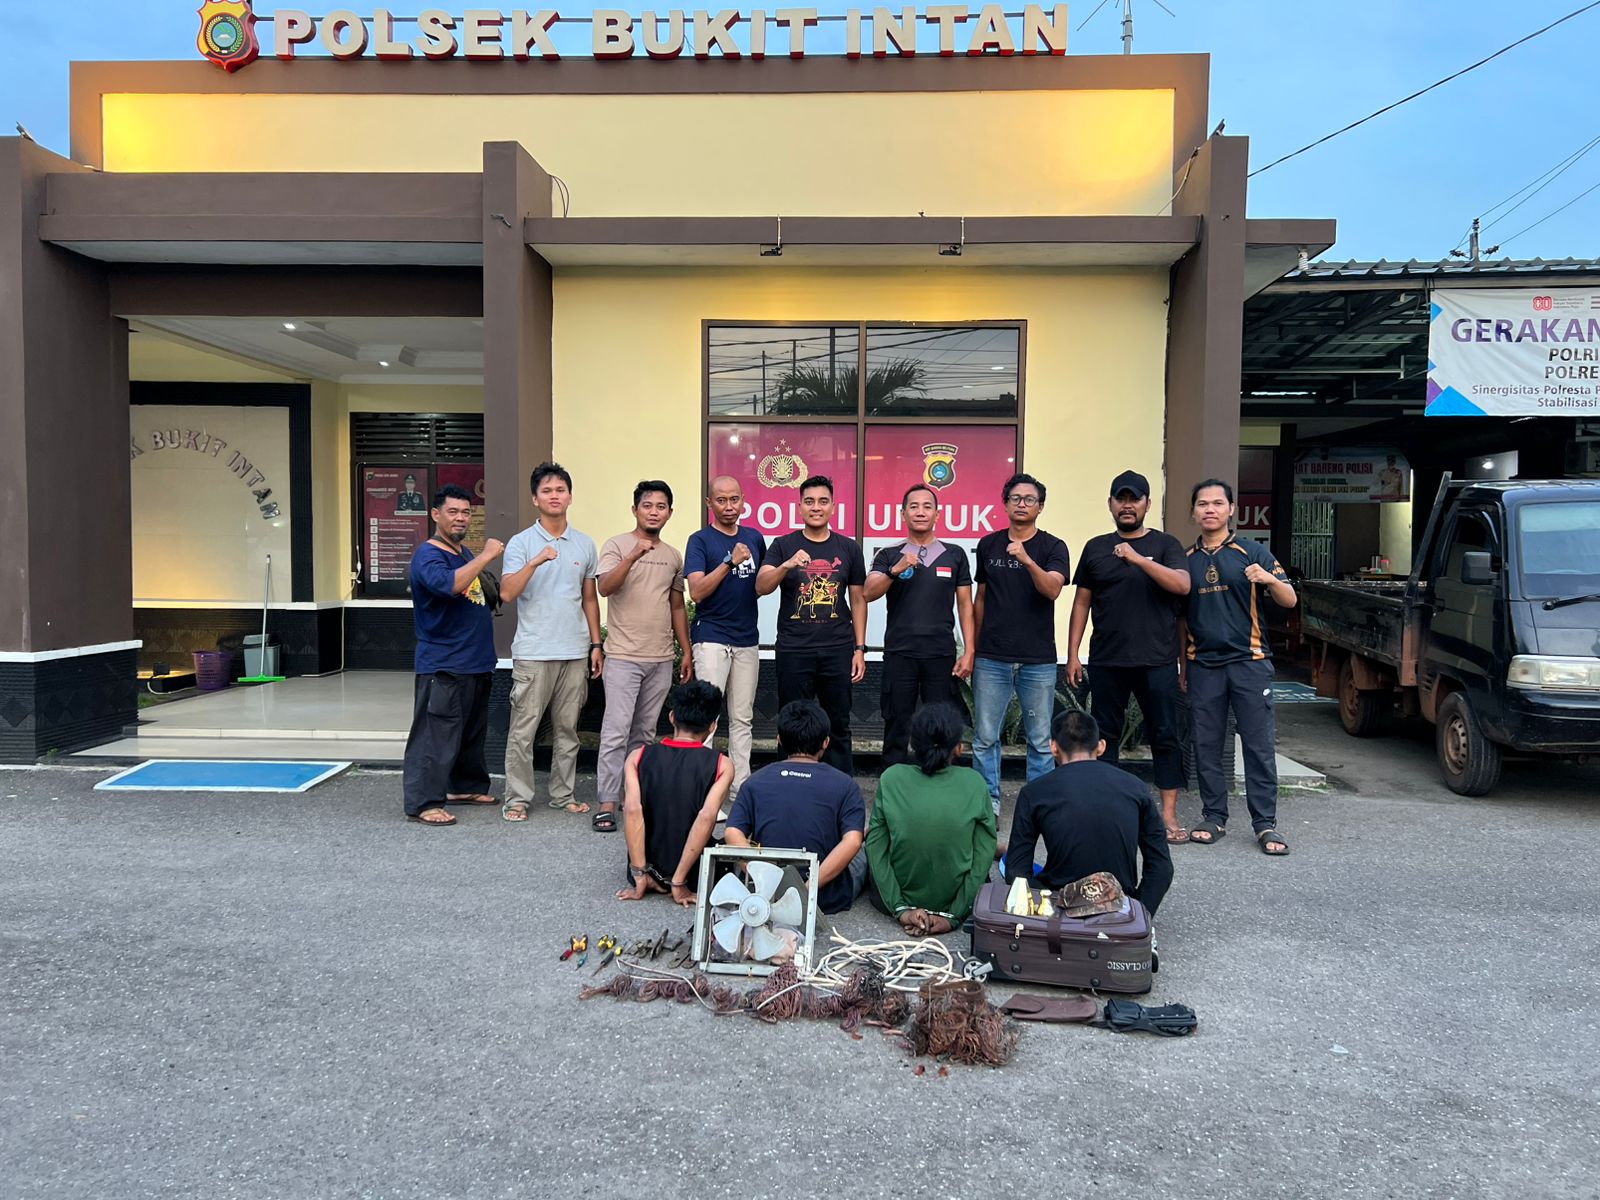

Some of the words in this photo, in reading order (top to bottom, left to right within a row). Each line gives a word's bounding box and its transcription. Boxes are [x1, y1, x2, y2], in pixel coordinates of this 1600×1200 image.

[274, 9, 560, 59] POLSEK
[592, 7, 818, 59] BUKIT
[846, 3, 1068, 57] INTAN
[1548, 348, 1598, 362] POLRI
[1472, 385, 1540, 397] Sinergisitas
[1543, 385, 1591, 395] Polresta
[1537, 397, 1597, 408] Stabilisasi
[152, 428, 227, 458] BUKIT
[227, 450, 281, 520] INTAN
[1346, 463, 1373, 474] POLISI
[735, 501, 845, 530] POLI
[1107, 961, 1142, 972] CLASSIC
